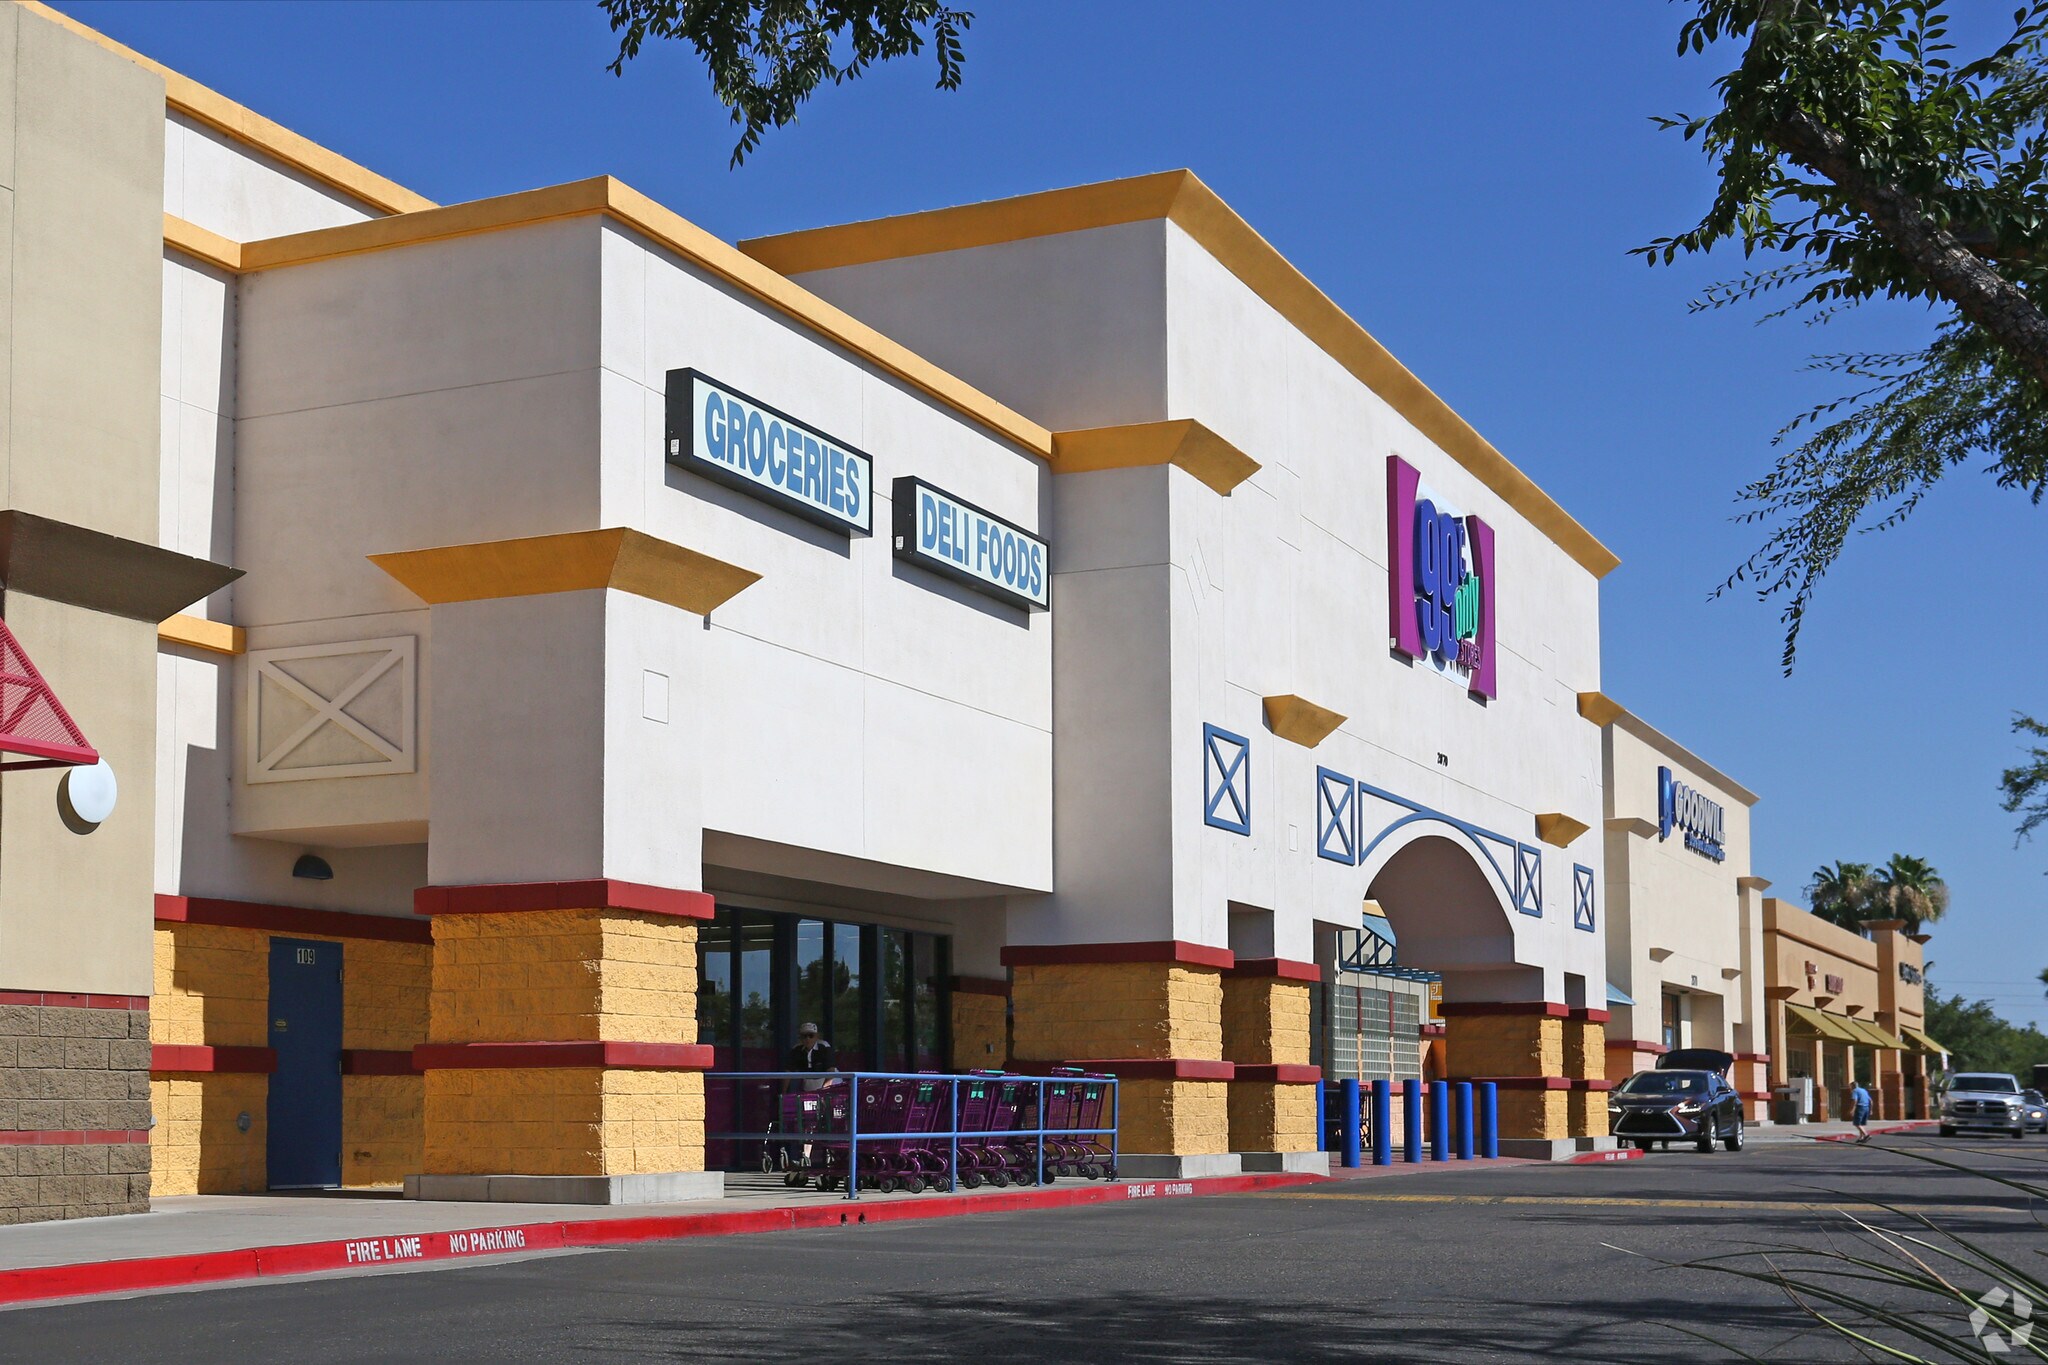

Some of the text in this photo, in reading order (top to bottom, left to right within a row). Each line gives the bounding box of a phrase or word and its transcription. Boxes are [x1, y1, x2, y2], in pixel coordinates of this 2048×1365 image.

[704, 391, 860, 518] GROCERIES
[921, 493, 1042, 598] DELI FOODS
[1673, 781, 1725, 846] GOODWILL
[298, 949, 314, 963] 109
[1128, 1183, 1193, 1198] FIRE LANE NO PARKING
[345, 1229, 526, 1263] FIRE LANE NO PARKING
